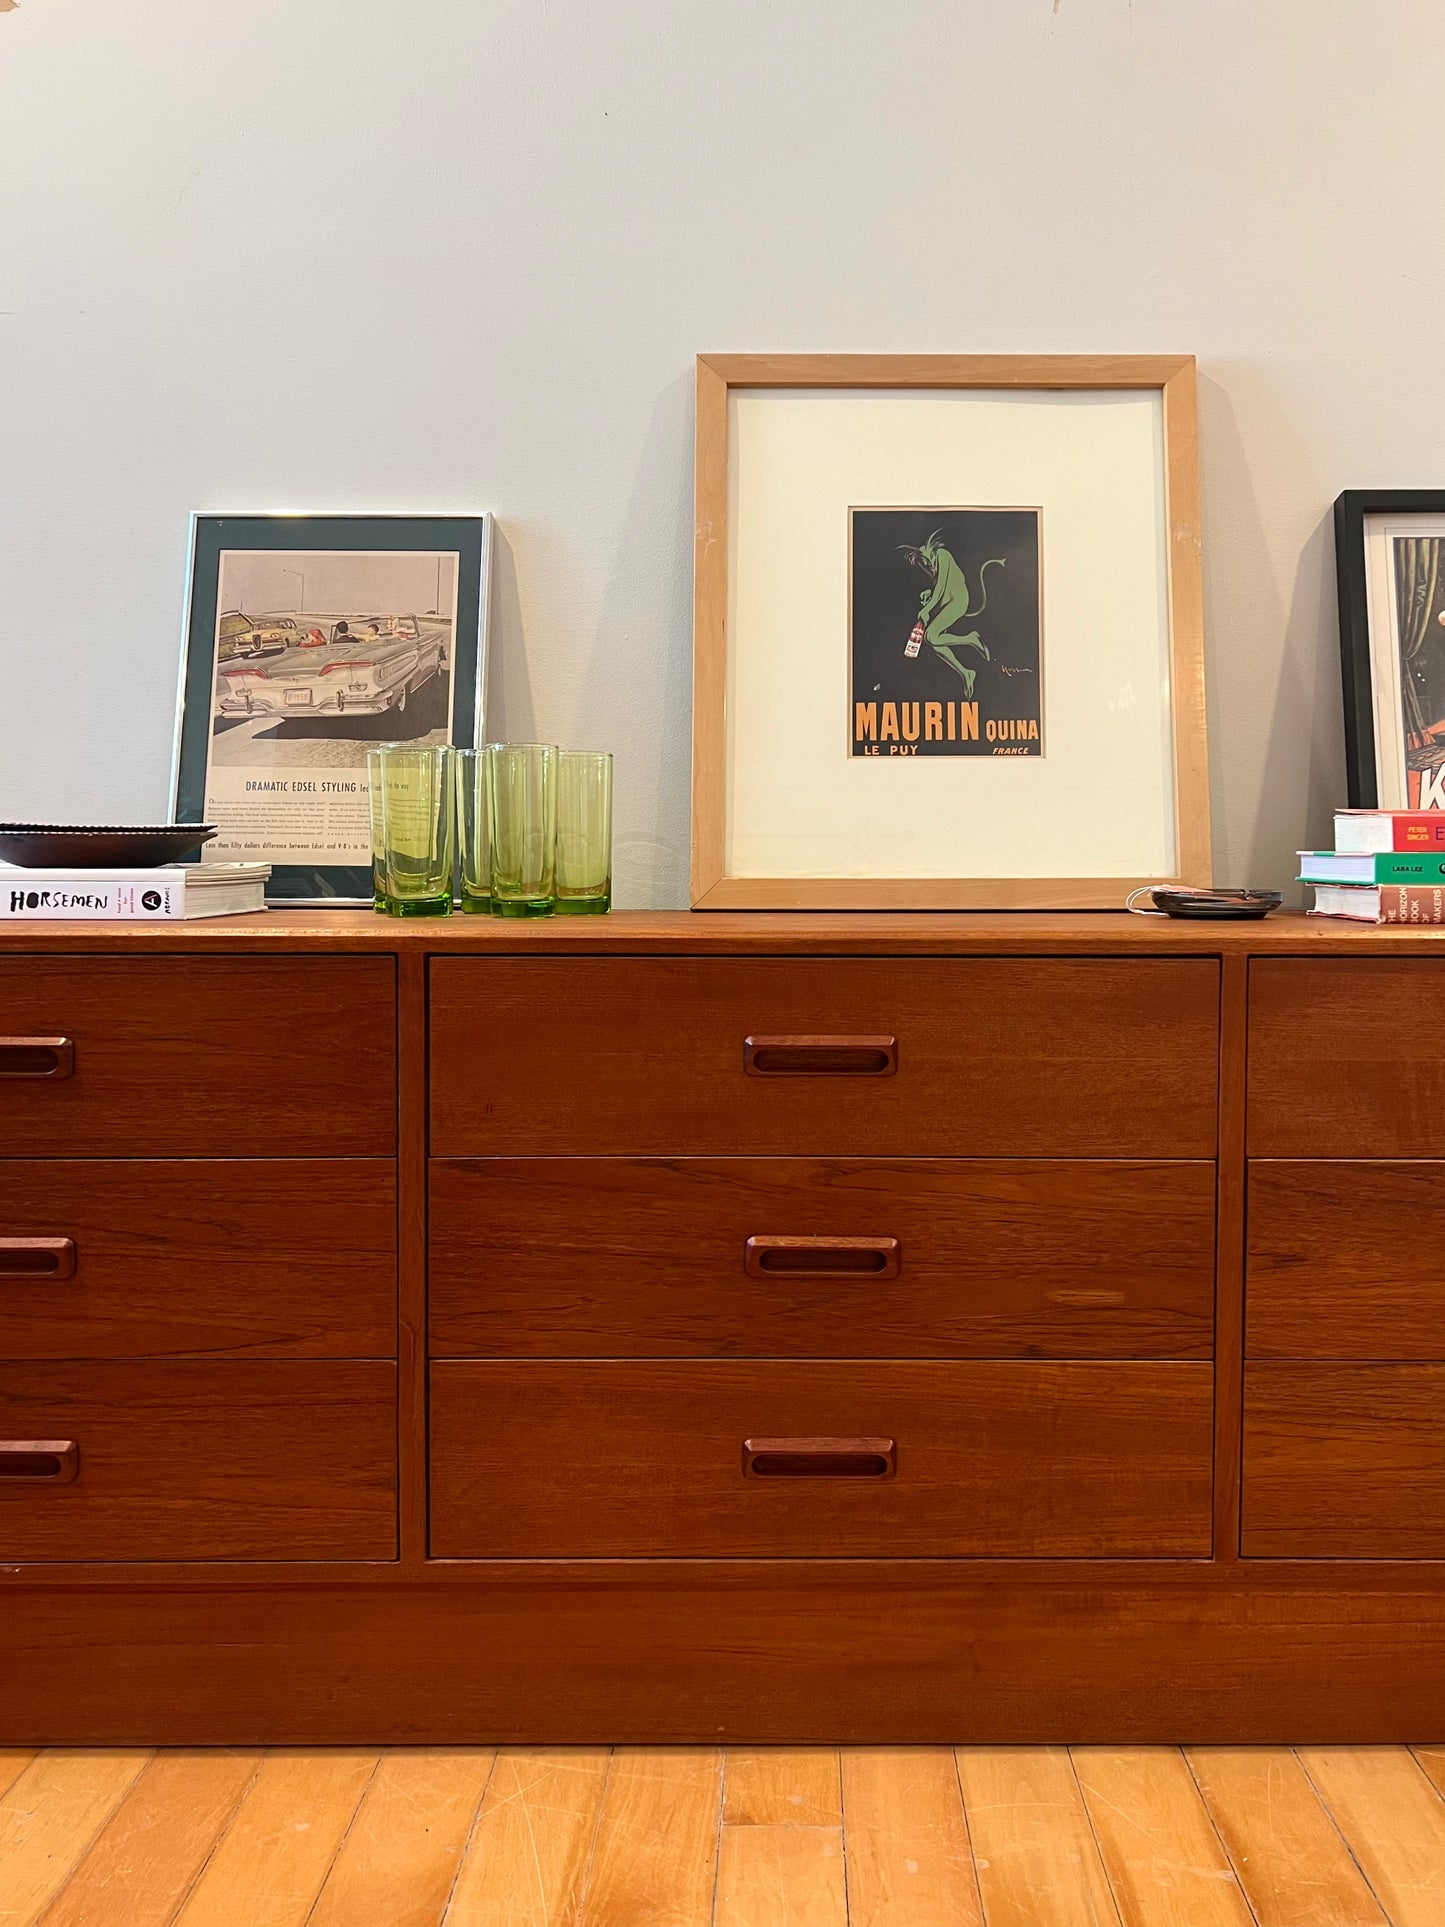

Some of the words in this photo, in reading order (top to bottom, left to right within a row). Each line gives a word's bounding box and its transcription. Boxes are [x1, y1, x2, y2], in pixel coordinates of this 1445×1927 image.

[855, 701, 979, 741] MAURIN
[986, 719, 1039, 742] QUINA
[864, 745, 880, 756] LE
[890, 745, 918, 756] PUY
[992, 747, 1029, 755] FRANCE
[245, 781, 288, 792] DRAMATIC
[292, 781, 317, 792] EDSEL
[321, 782, 357, 793] STYLING
[1407, 833, 1430, 841] SINGER
[231, 842, 242, 850] fifty
[10, 890, 108, 913] HORSEMEN
